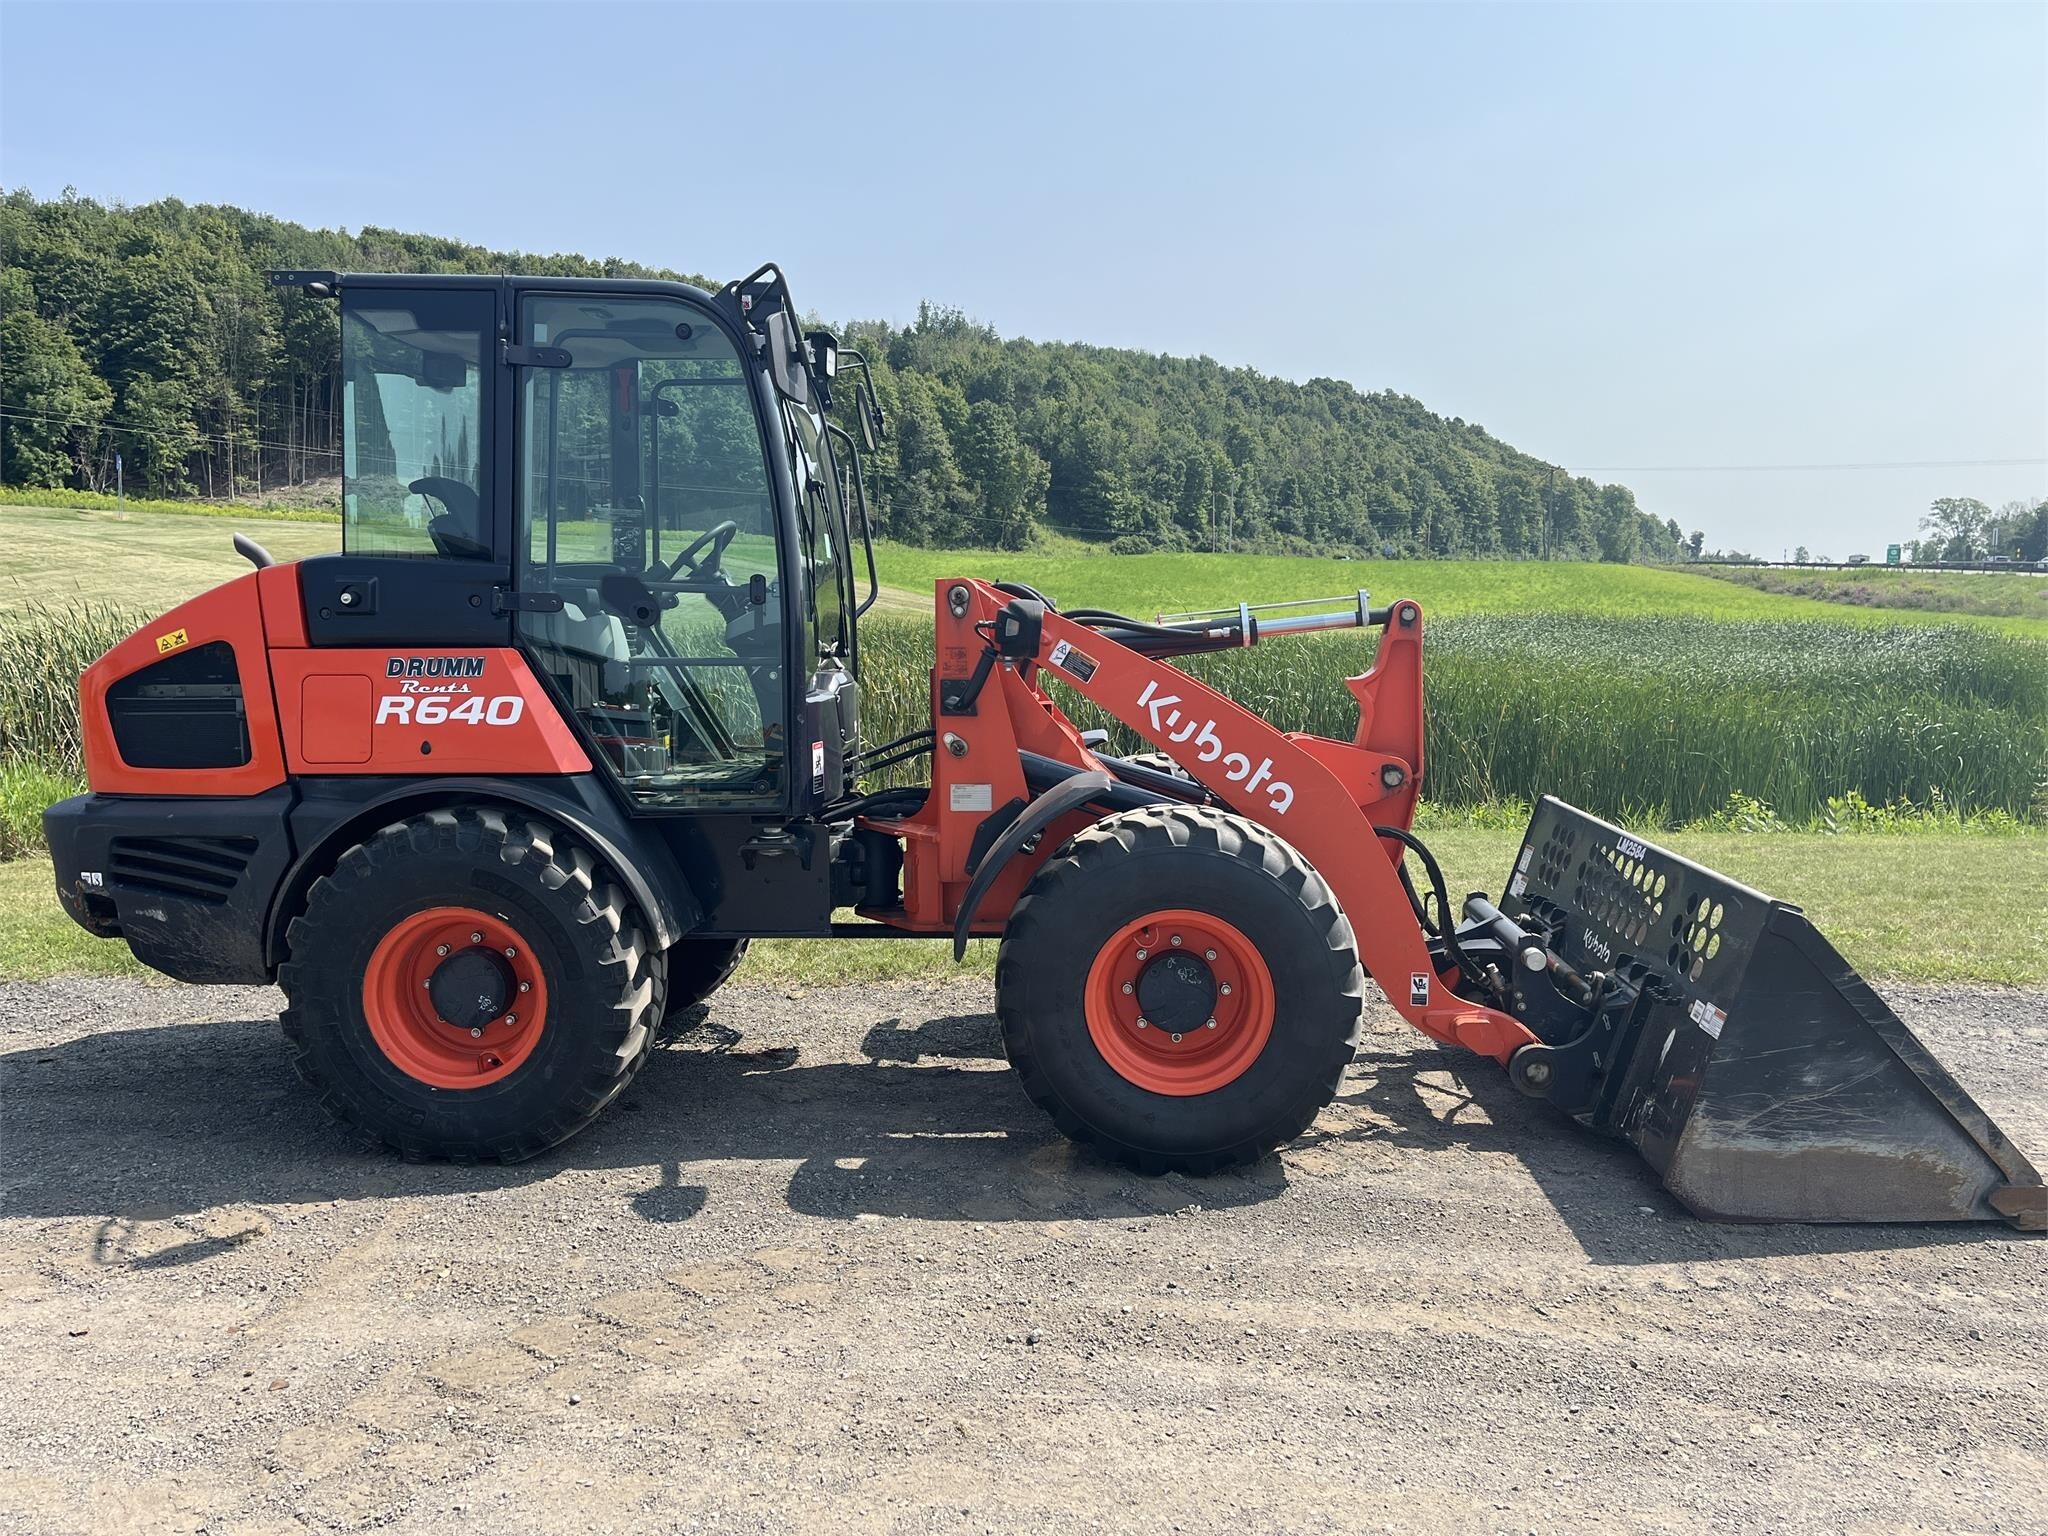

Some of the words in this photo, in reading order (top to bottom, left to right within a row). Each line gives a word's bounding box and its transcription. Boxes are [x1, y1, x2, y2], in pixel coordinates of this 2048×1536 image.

[386, 656, 485, 678] DRUMM
[400, 680, 472, 693] Rents
[375, 695, 525, 726] R640
[1136, 680, 1295, 815] Kubota
[1616, 836, 1647, 861] LM2584
[1583, 928, 1611, 964] Kubota
